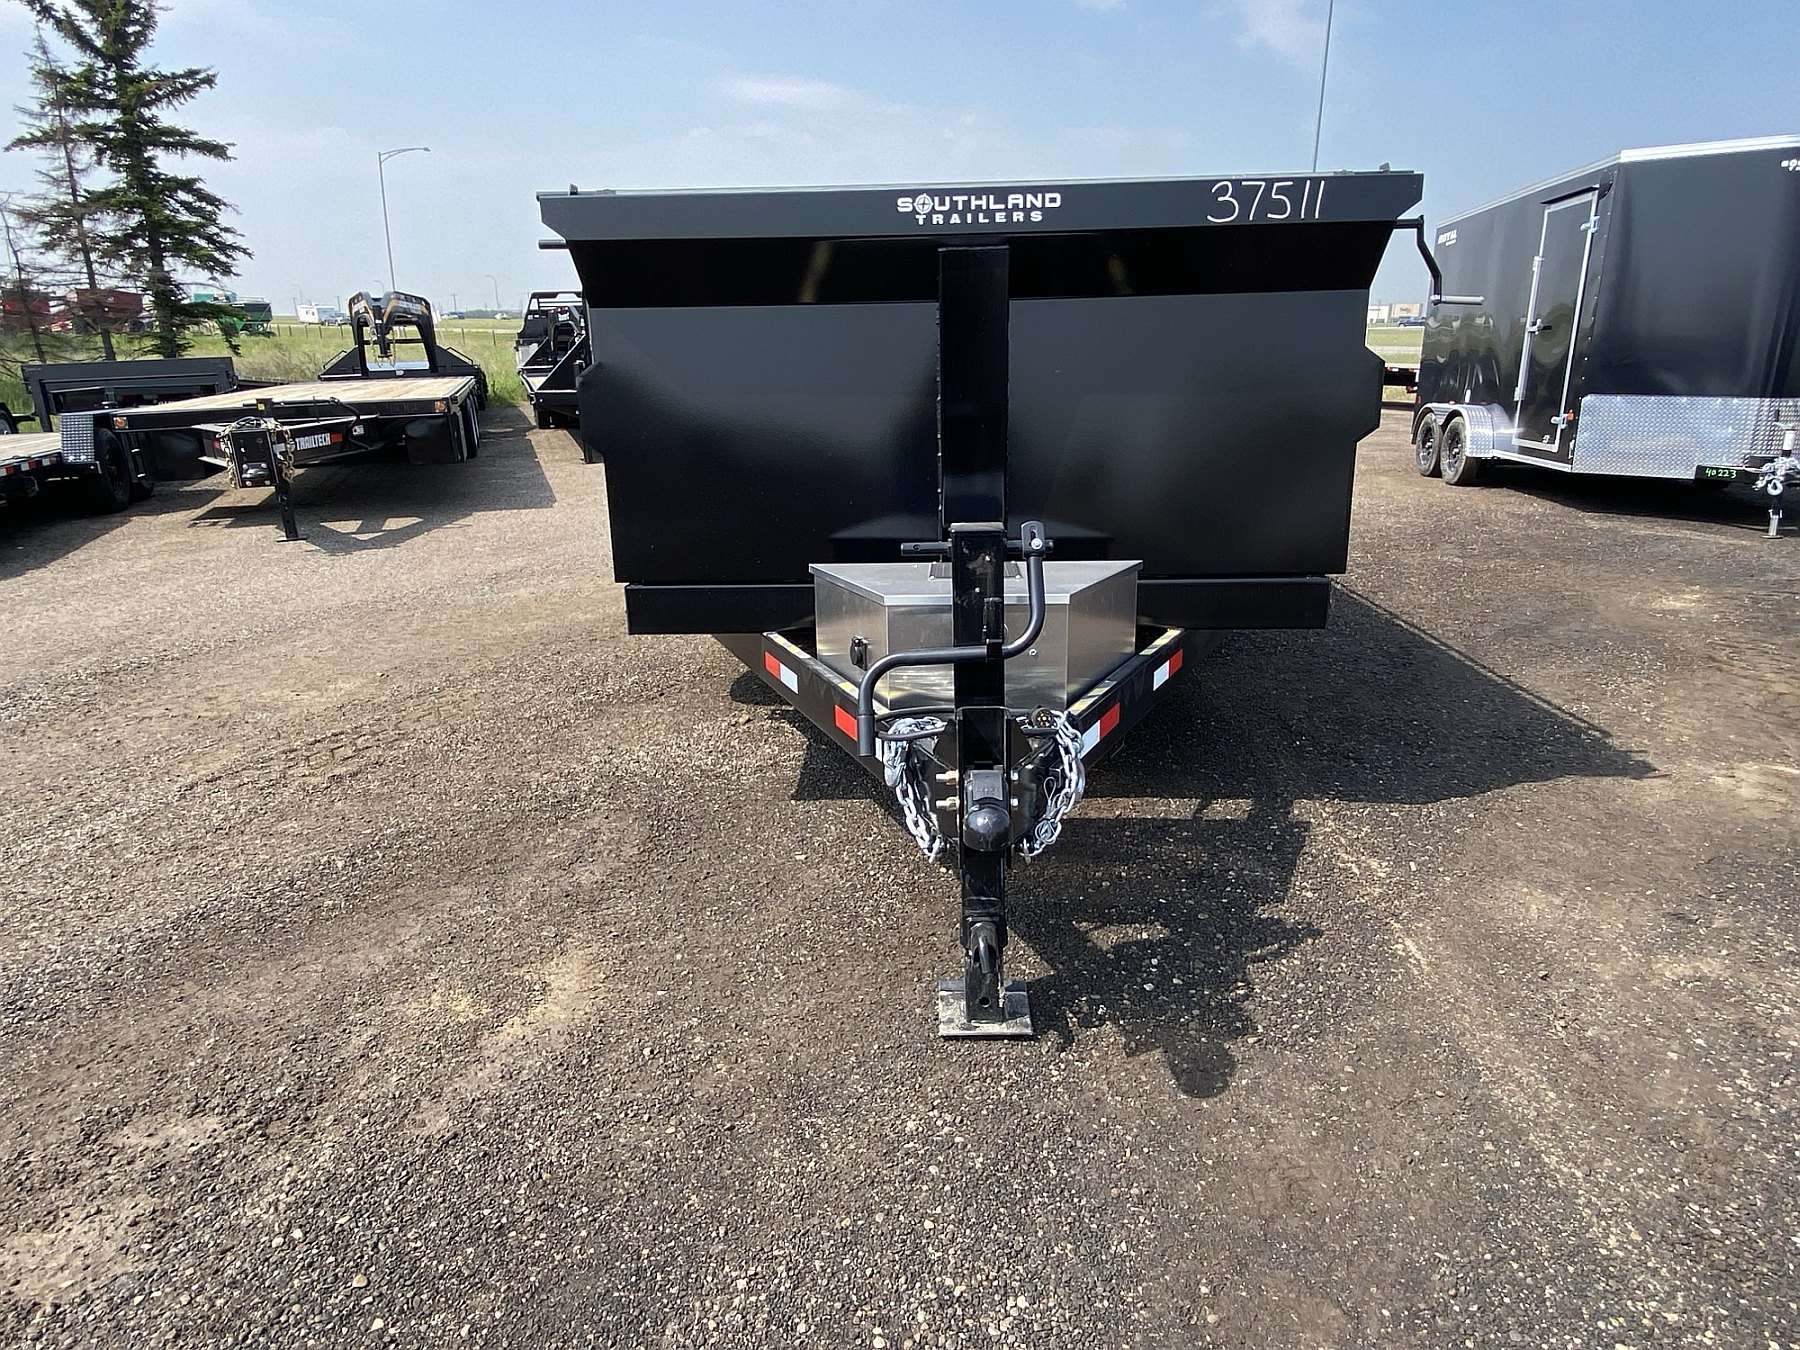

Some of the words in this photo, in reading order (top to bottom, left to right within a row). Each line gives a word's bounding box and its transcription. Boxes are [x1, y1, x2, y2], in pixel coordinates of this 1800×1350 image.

[897, 193, 1061, 214] SOUTHLAND
[1207, 180, 1325, 223] 37511
[915, 211, 1043, 225] TRAILERS
[295, 433, 331, 450] TRAILTECH
[1705, 467, 1737, 479] 40223
